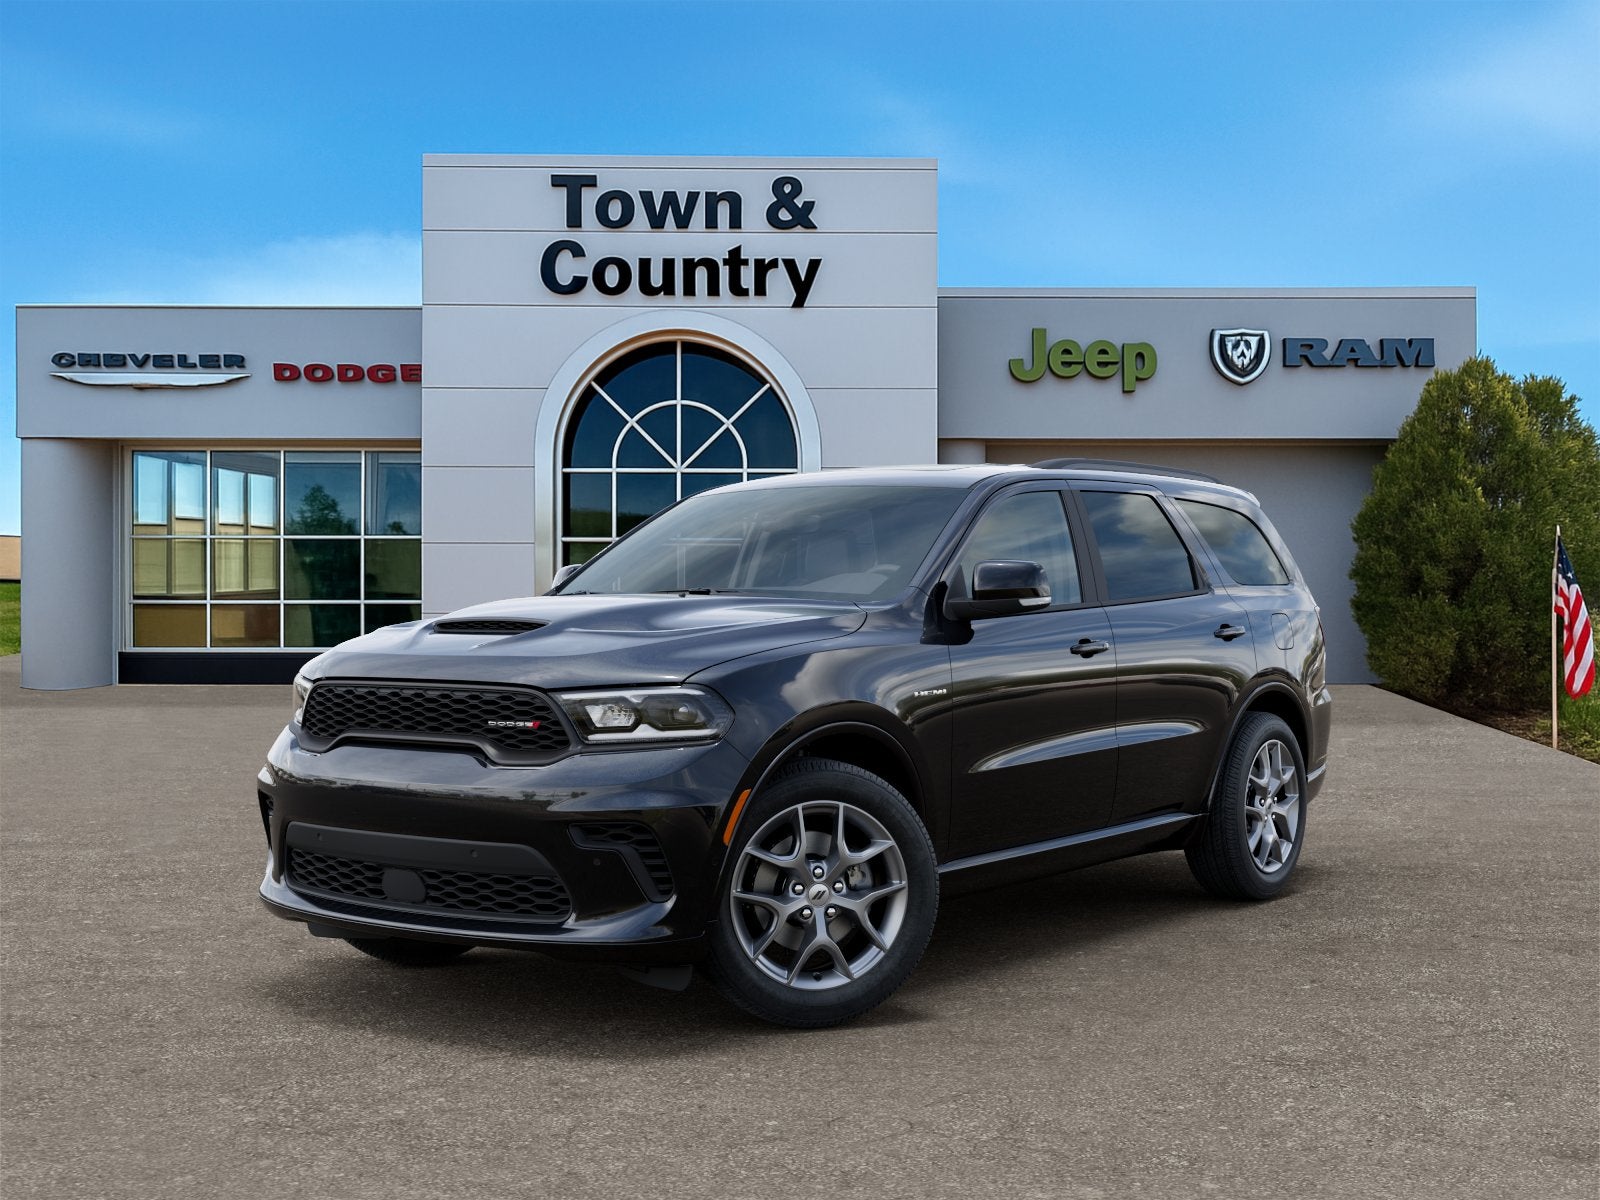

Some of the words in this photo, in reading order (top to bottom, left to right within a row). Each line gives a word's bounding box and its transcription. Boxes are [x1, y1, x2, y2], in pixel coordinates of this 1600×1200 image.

[551, 174, 742, 229] Town
[766, 176, 817, 229] &
[540, 239, 822, 308] Country
[273, 362, 422, 383] DODGE
[1009, 328, 1157, 392] Jeep
[1283, 338, 1436, 367] RAM
